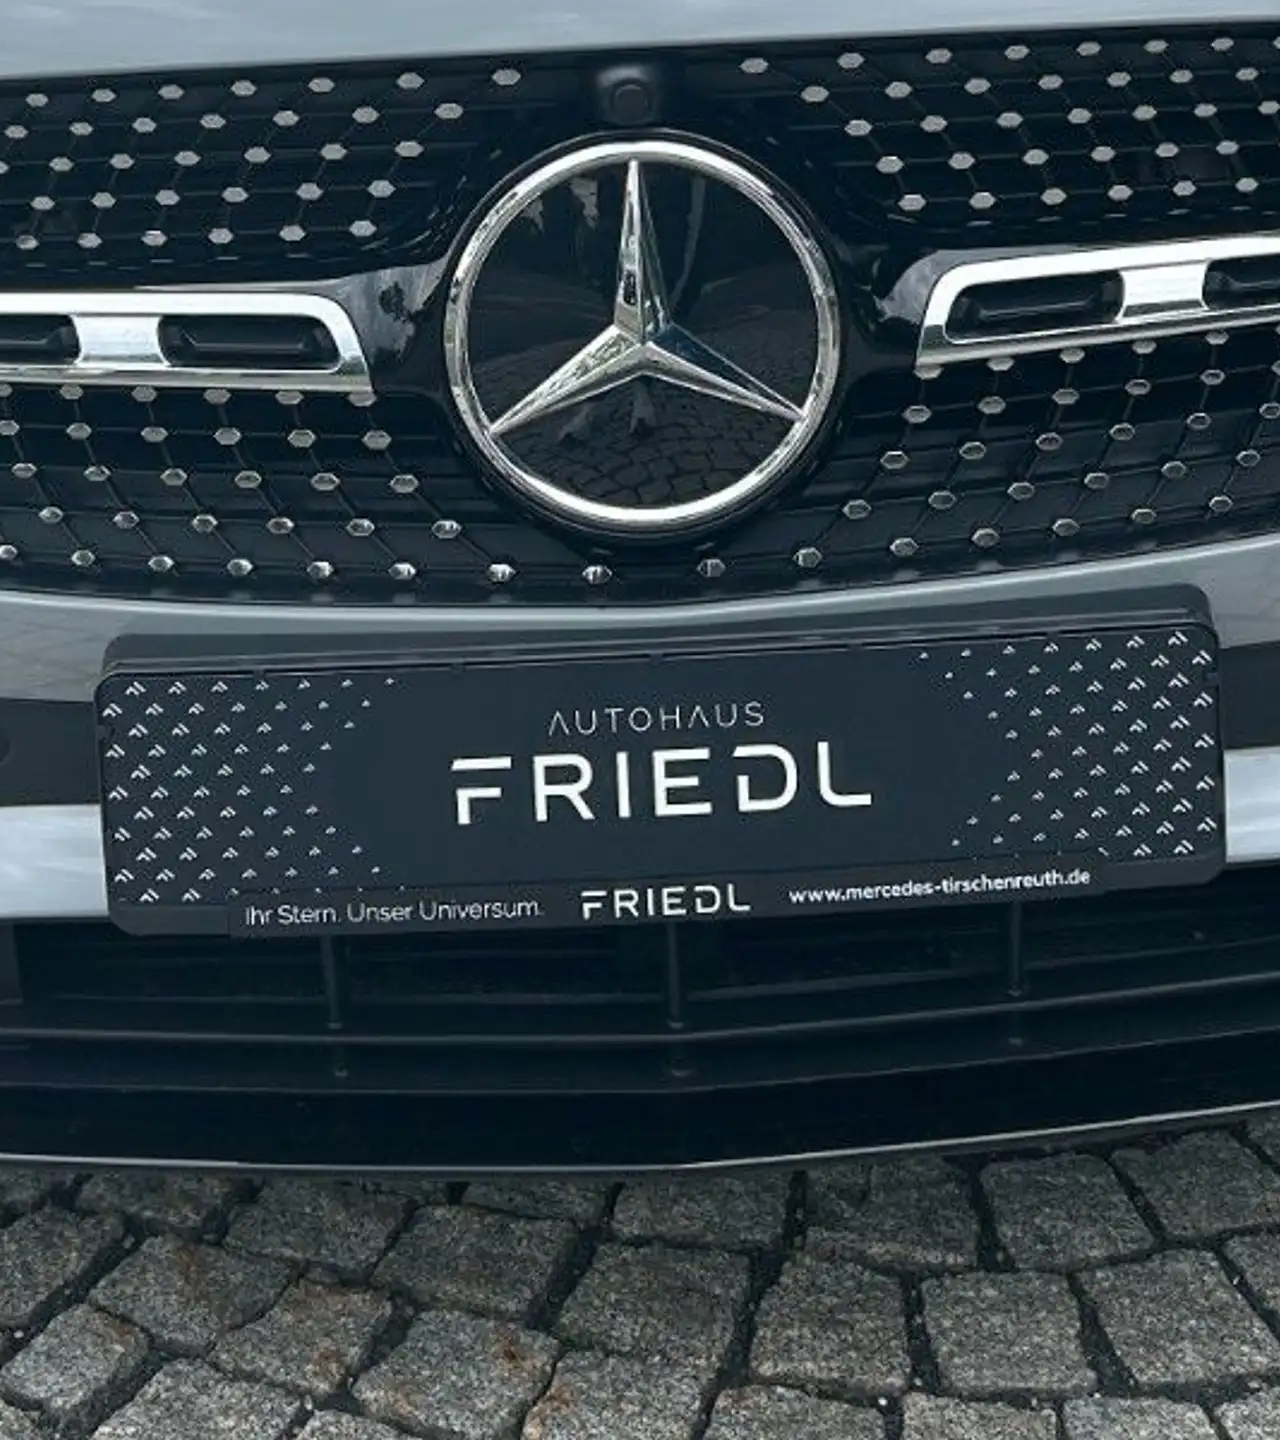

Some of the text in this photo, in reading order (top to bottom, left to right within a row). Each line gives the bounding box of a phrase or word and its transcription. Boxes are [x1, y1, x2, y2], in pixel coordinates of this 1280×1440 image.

[548, 700, 766, 737] AUTOHAUS
[451, 741, 873, 825] FRIEDL
[580, 882, 752, 921] FRIEDL
[788, 867, 1091, 904] www.mercedes-tirschenreuth.de
[245, 898, 545, 926] Ihr Stern. Unser Universum.
